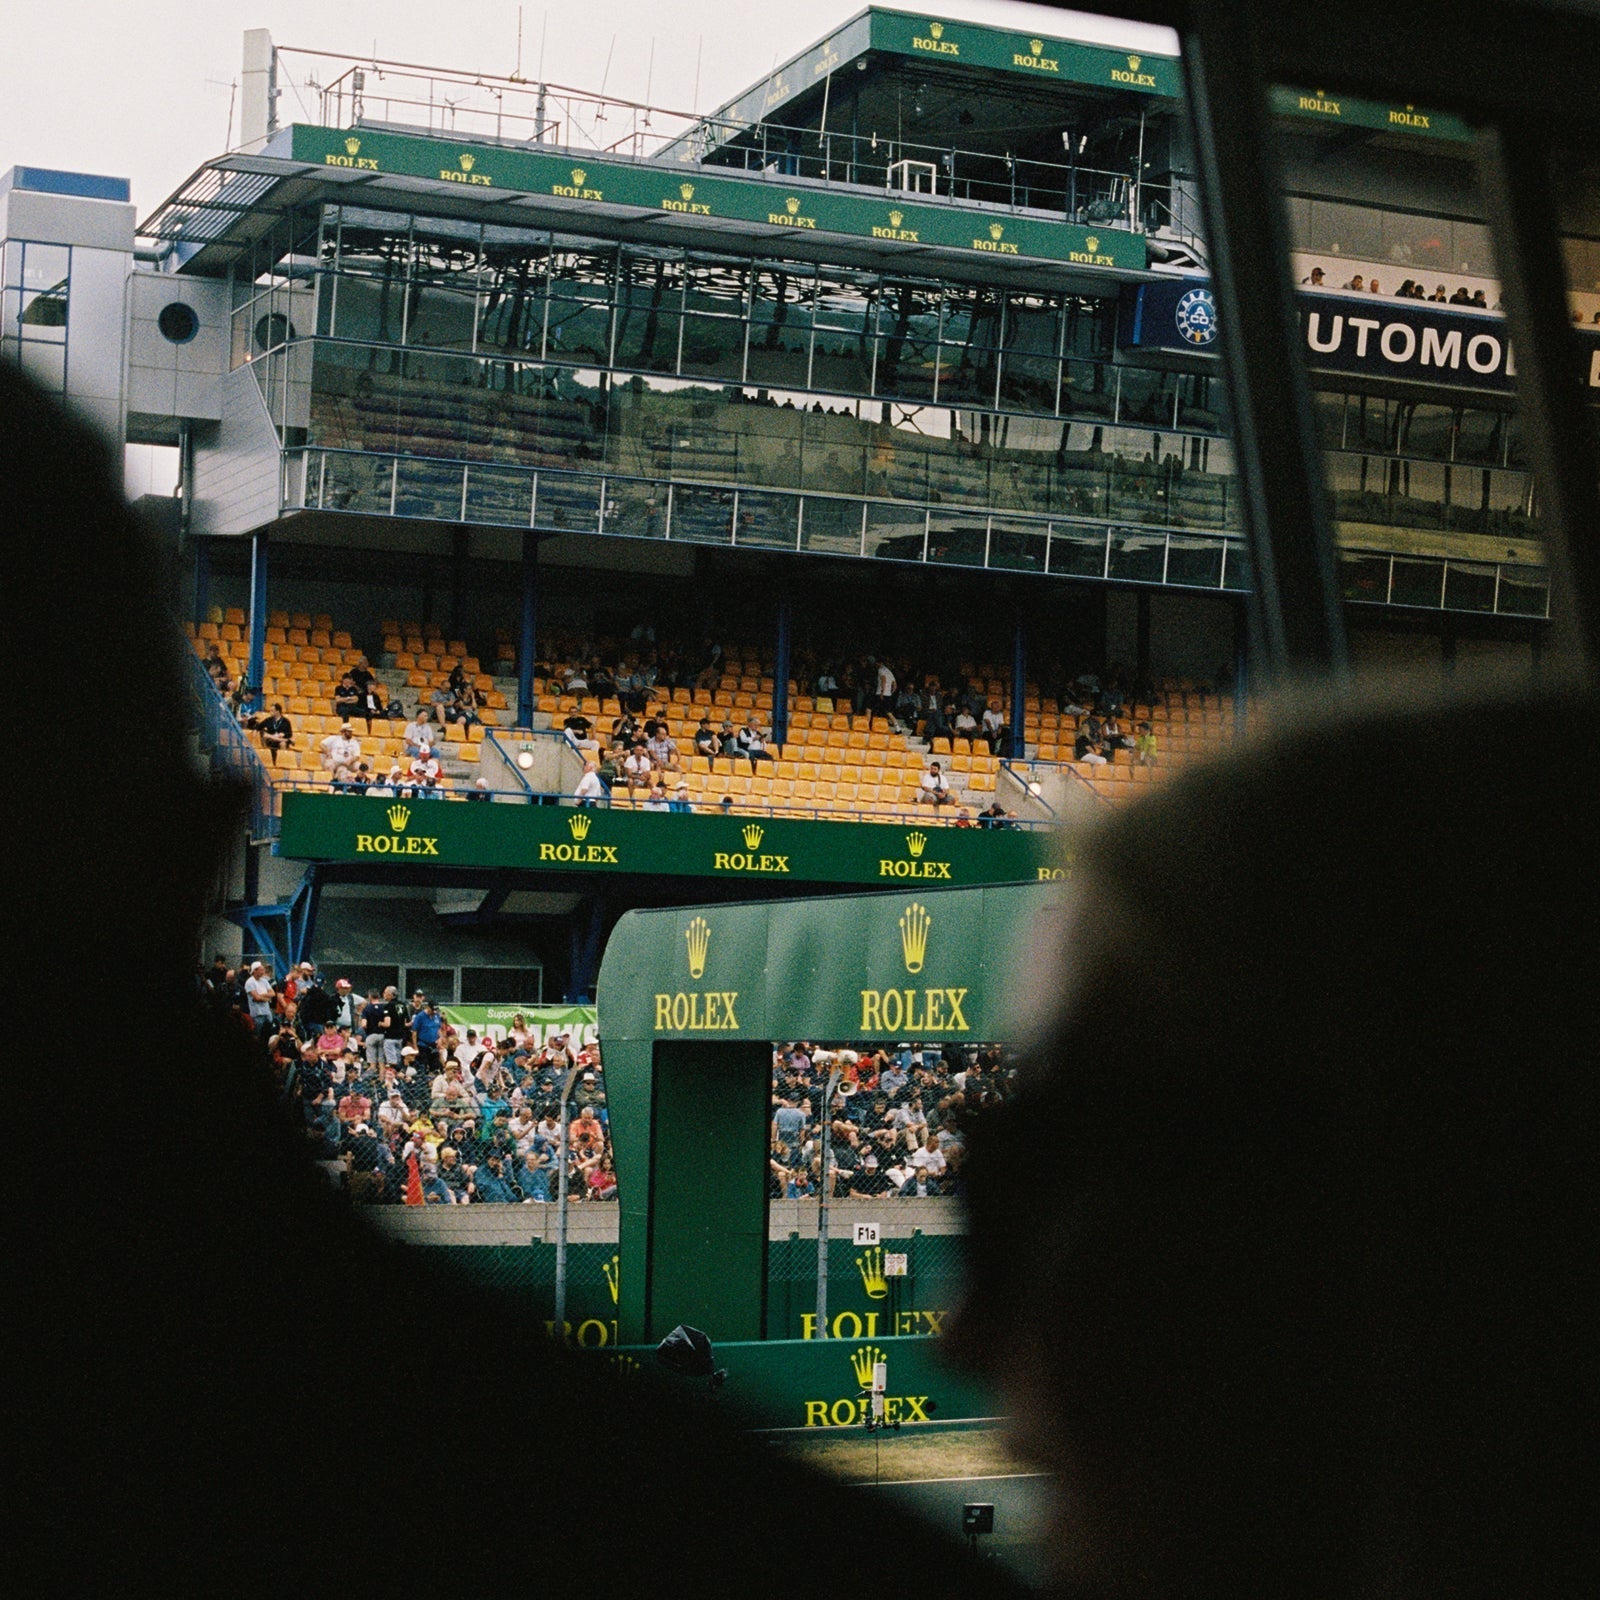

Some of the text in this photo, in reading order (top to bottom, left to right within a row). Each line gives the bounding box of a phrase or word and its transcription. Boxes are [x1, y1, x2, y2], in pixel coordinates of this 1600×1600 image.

[913, 37, 960, 55] ROLEX
[1013, 54, 1059, 72] ROLEX
[1111, 69, 1156, 87] ROLEX
[1299, 97, 1341, 115] ROLEX
[1389, 111, 1430, 128] ROLEX
[325, 153, 379, 170] ROLEX
[440, 170, 492, 186] ROLEX
[553, 185, 603, 201] ROLEX
[662, 199, 711, 215] ROLEX
[768, 213, 816, 229] ROLEX
[872, 227, 919, 242] ROLEX
[973, 239, 1018, 255] ROLEX
[1069, 252, 1114, 267] ROLEX
[356, 834, 439, 855] ROLEX
[539, 844, 619, 863] ROLEX
[714, 853, 790, 872] ROLEX
[879, 860, 952, 879] ROLEX
[655, 992, 739, 1030] ROLEX
[860, 988, 969, 1031] ROLEX
[858, 1227, 876, 1240] F1a
